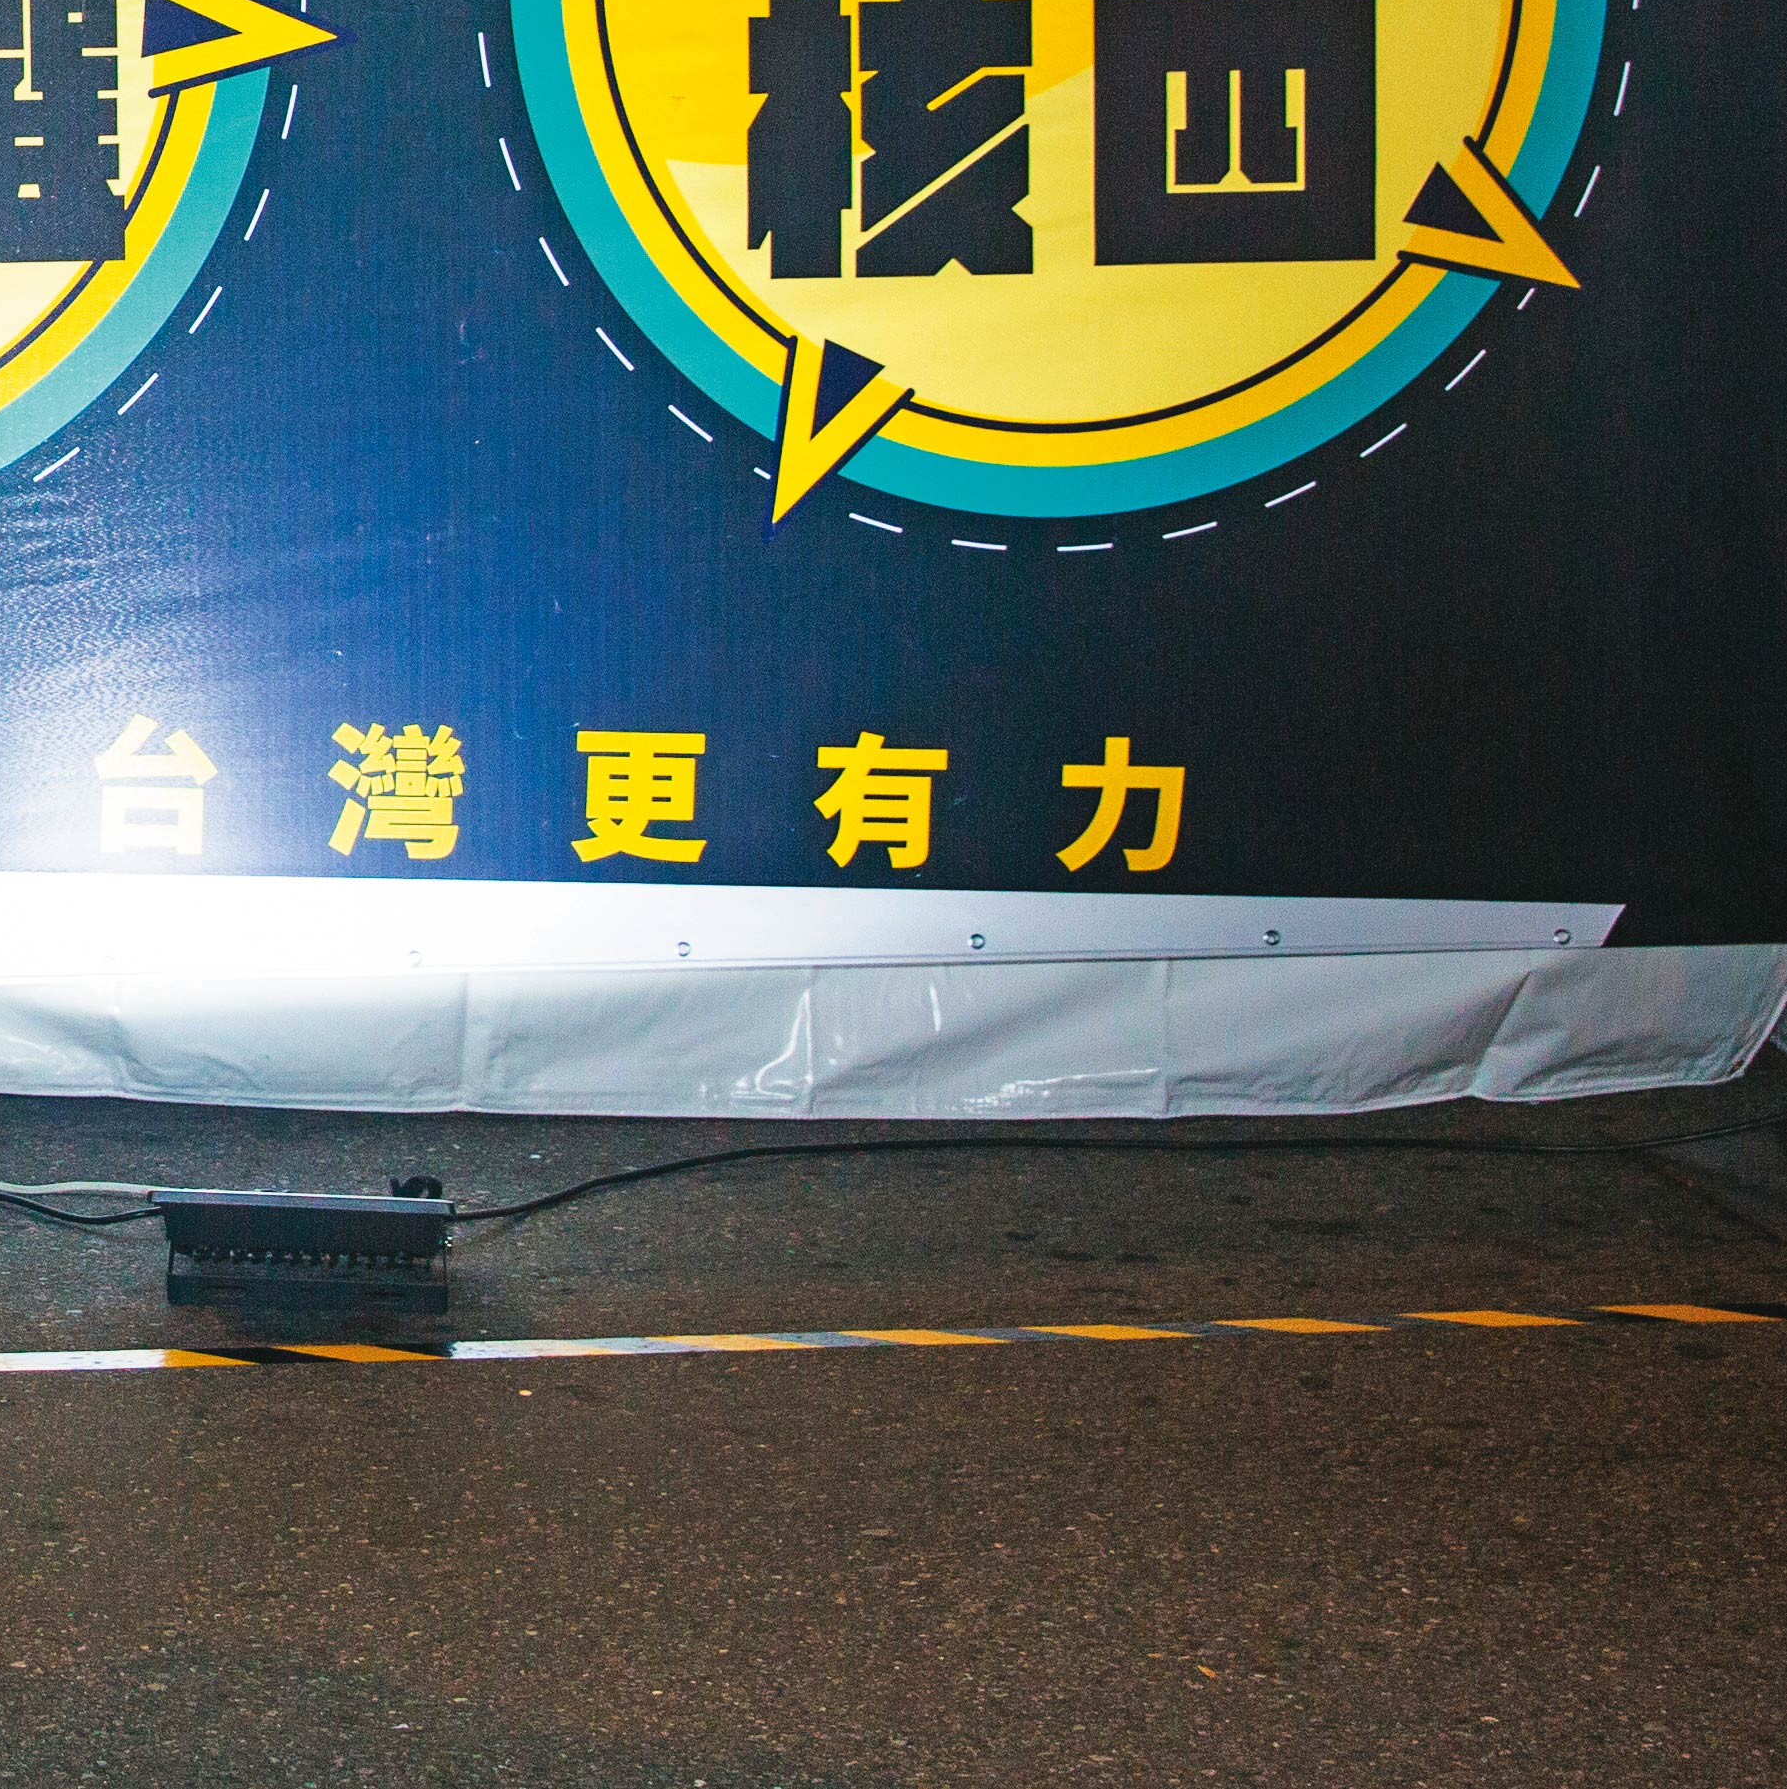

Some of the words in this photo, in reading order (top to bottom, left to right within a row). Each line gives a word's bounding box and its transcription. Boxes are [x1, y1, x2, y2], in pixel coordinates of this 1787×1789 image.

[92, 712, 1187, 873] 台灣更有力
